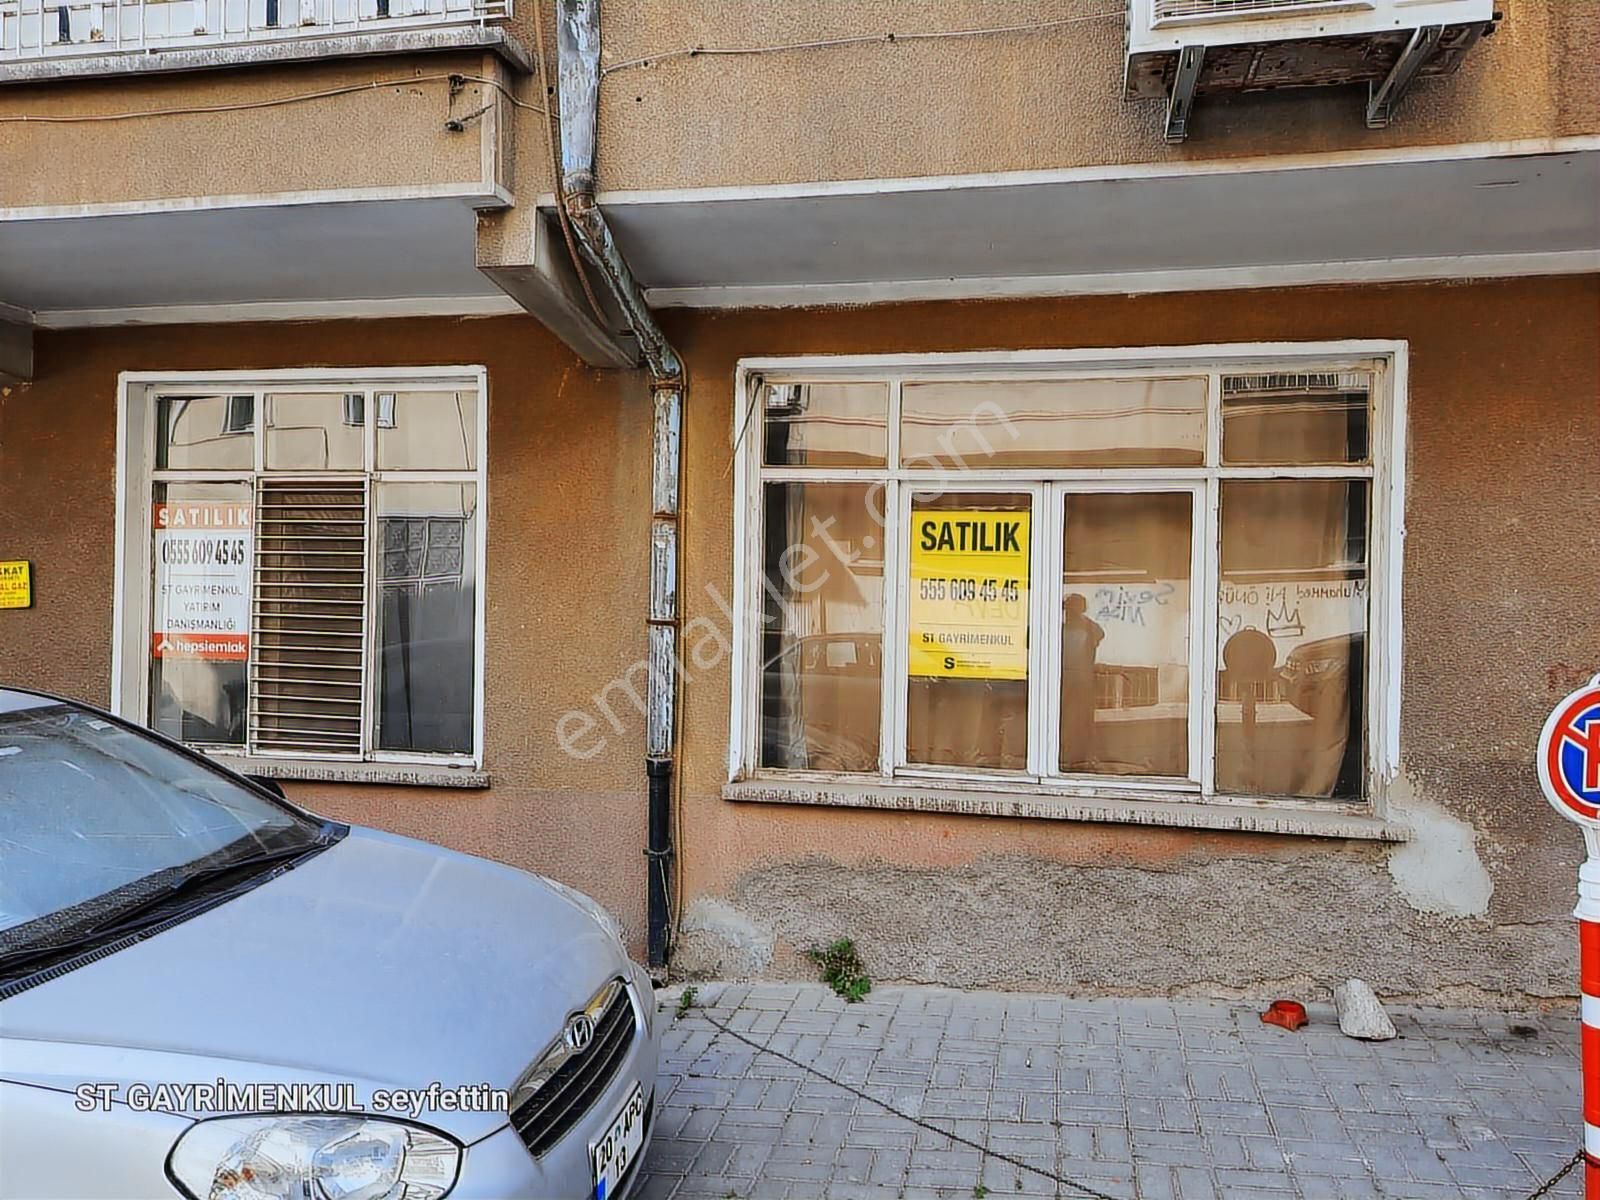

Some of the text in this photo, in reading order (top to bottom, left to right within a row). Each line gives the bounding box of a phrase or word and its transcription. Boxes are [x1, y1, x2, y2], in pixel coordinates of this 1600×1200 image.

[158, 507, 249, 526] SATILIK
[920, 520, 1020, 552] SATILIK
[162, 539, 190, 565] 0555
[192, 539, 213, 565] 609
[920, 578, 1019, 602] 555 609 45 45
[176, 639, 247, 654] hepsiemlak
[922, 631, 1014, 646] ST GAYRİMENKUL
[943, 656, 956, 670] S
[600, 1135, 613, 1173] 20
